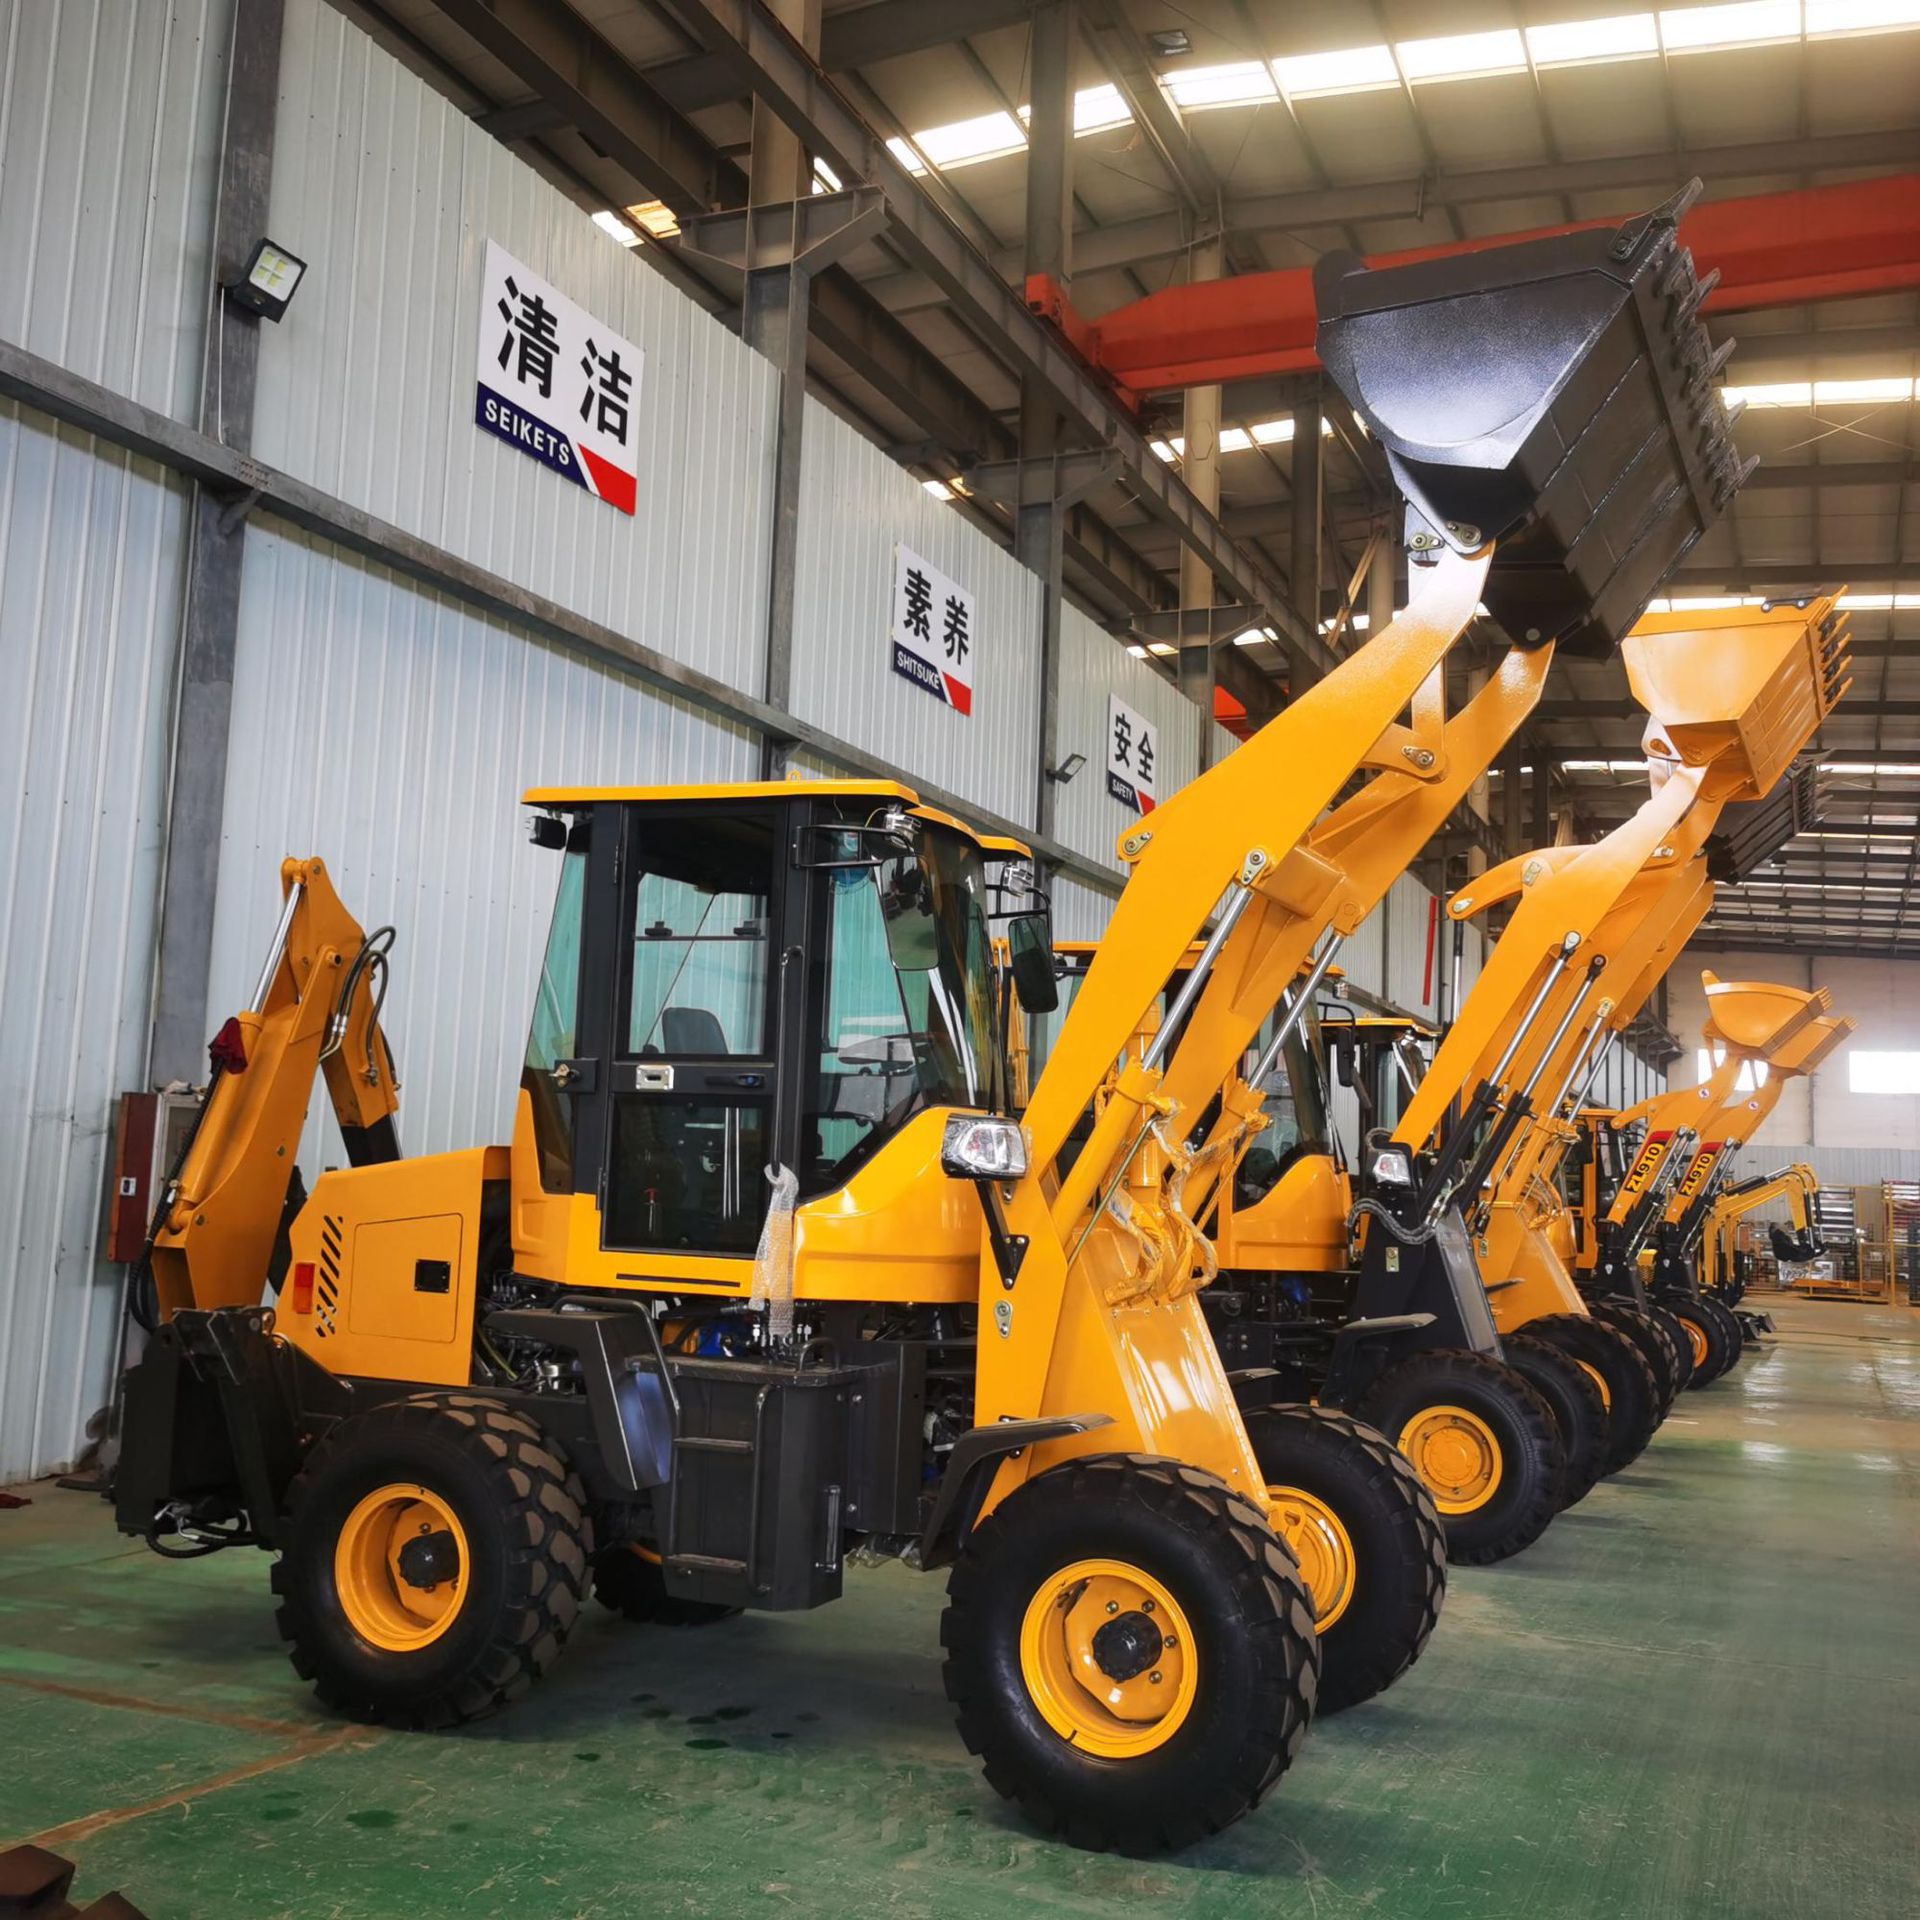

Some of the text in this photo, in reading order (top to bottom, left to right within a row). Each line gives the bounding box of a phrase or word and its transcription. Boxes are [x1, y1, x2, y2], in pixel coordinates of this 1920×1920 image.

[498, 275, 632, 446] 清洁
[485, 398, 570, 466] SEIKETS
[903, 567, 969, 666] 素养
[896, 651, 940, 690] SHITSUKE
[1114, 713, 1154, 784] 安全
[1112, 778, 1133, 801] SAFETY
[1626, 1145, 1662, 1193] ZL910
[1681, 1155, 1711, 1196] ZL910
